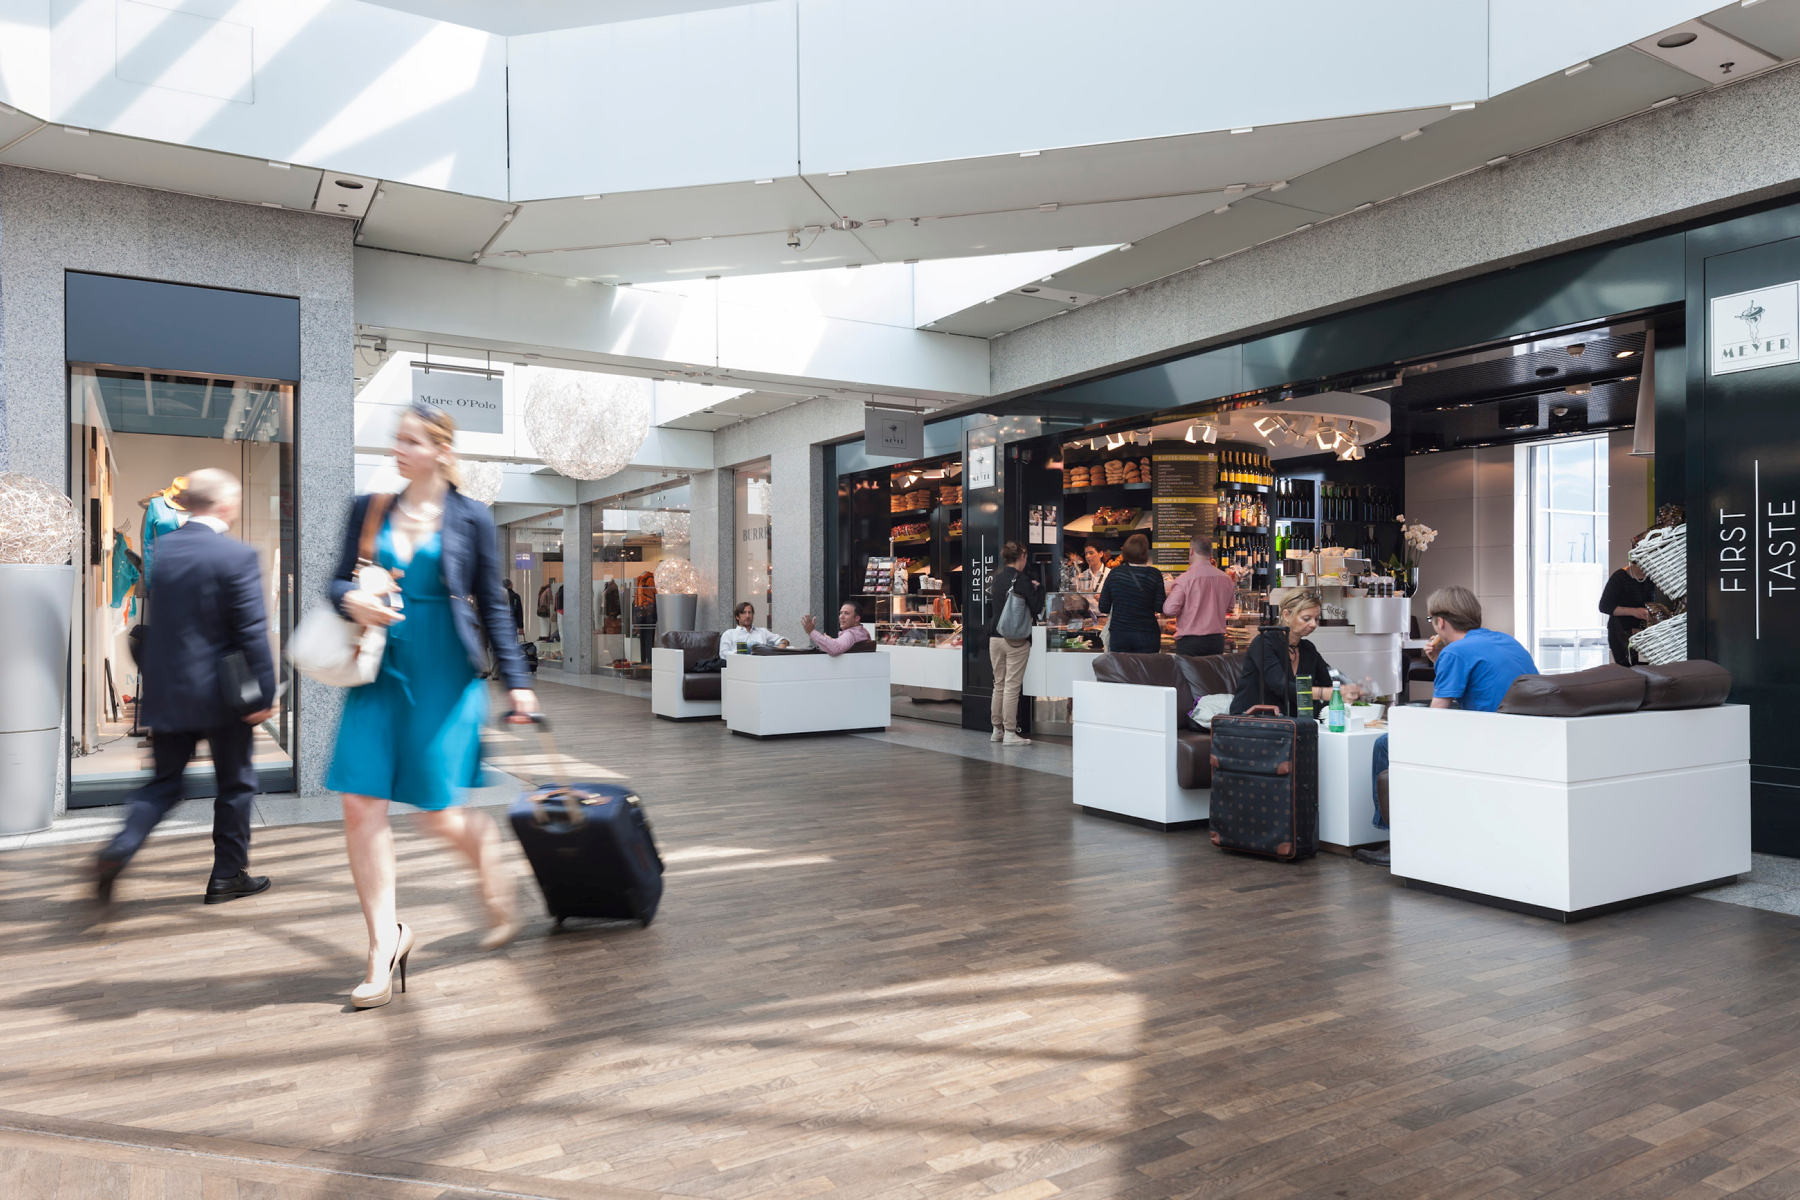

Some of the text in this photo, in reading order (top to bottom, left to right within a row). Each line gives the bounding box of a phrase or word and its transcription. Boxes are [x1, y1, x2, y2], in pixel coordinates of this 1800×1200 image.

[1721, 338, 1791, 359] MEYER
[420, 395, 497, 409] Marc O'Polo
[1720, 508, 1746, 592] FIRST
[1768, 500, 1796, 597] TASTE
[972, 558, 981, 602] FIRST
[985, 555, 994, 604] TASTE
